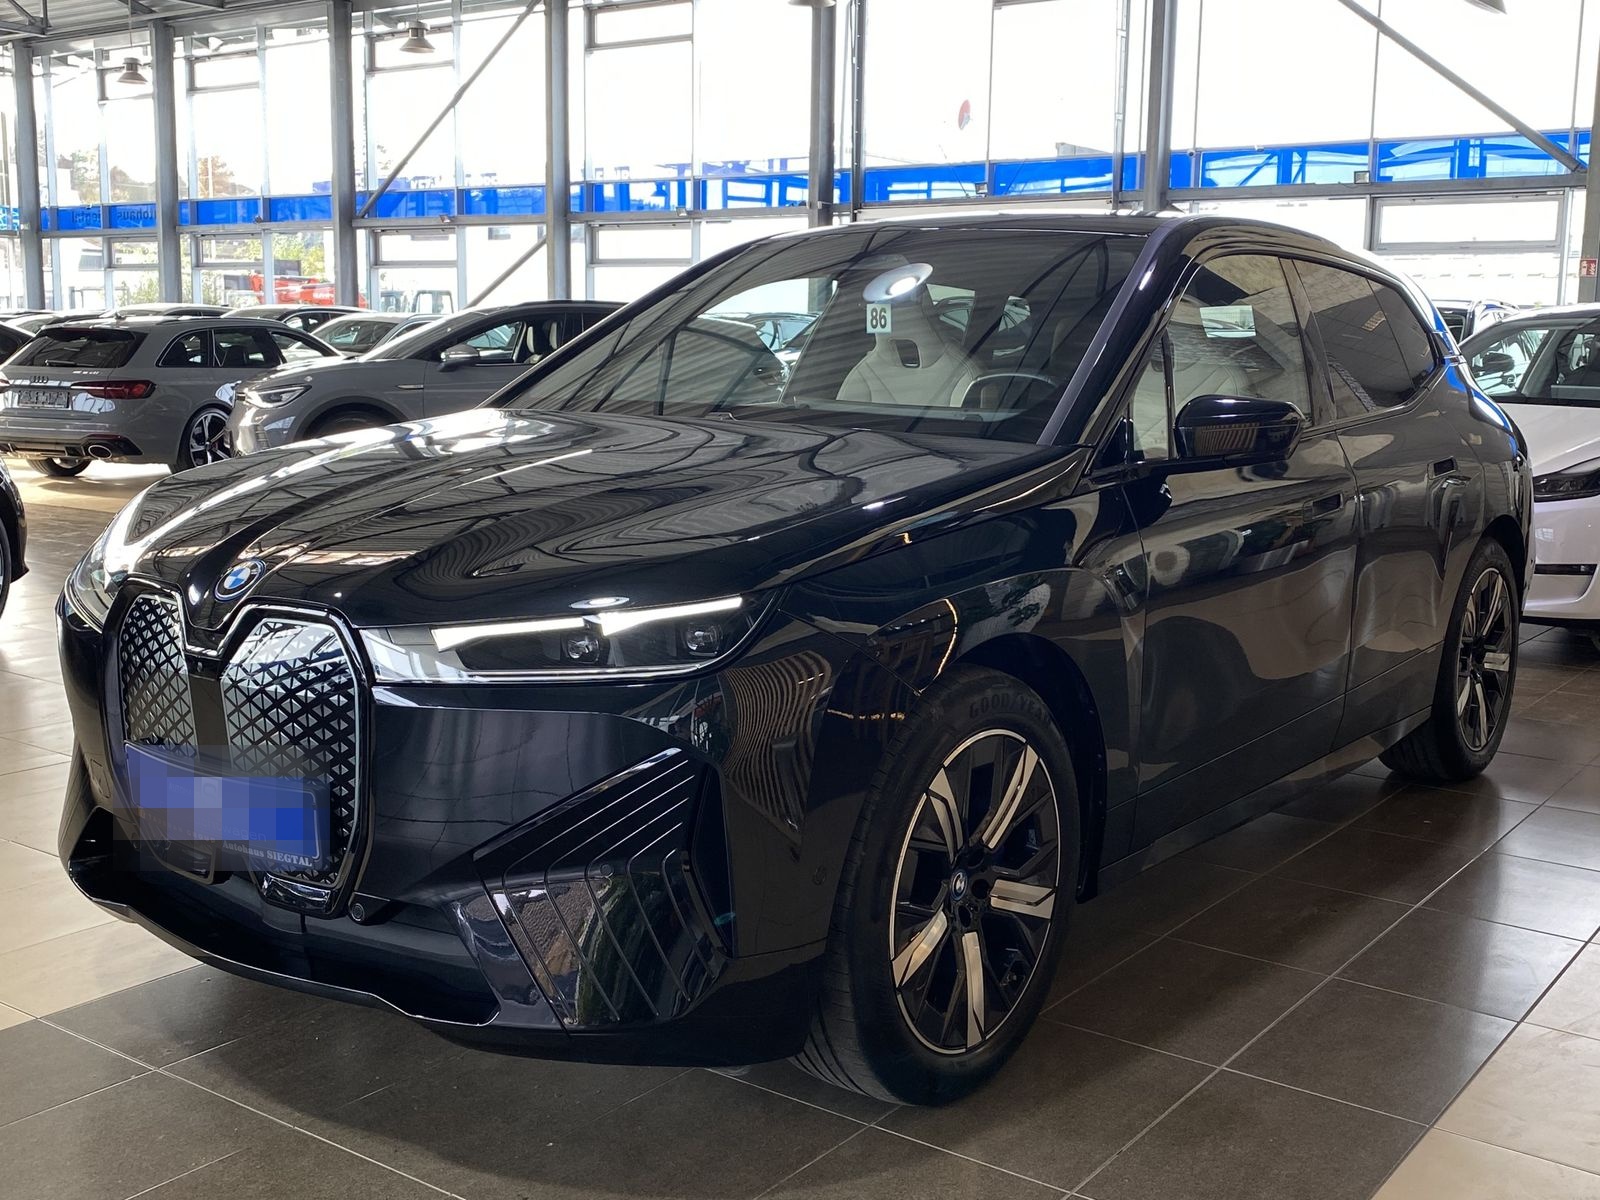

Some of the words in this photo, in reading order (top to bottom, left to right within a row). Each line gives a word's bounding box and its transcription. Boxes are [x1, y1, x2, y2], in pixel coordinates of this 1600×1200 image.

[870, 307, 887, 329] 86
[222, 840, 265, 858] Autohaus
[266, 849, 313, 867] SIEGTAL
